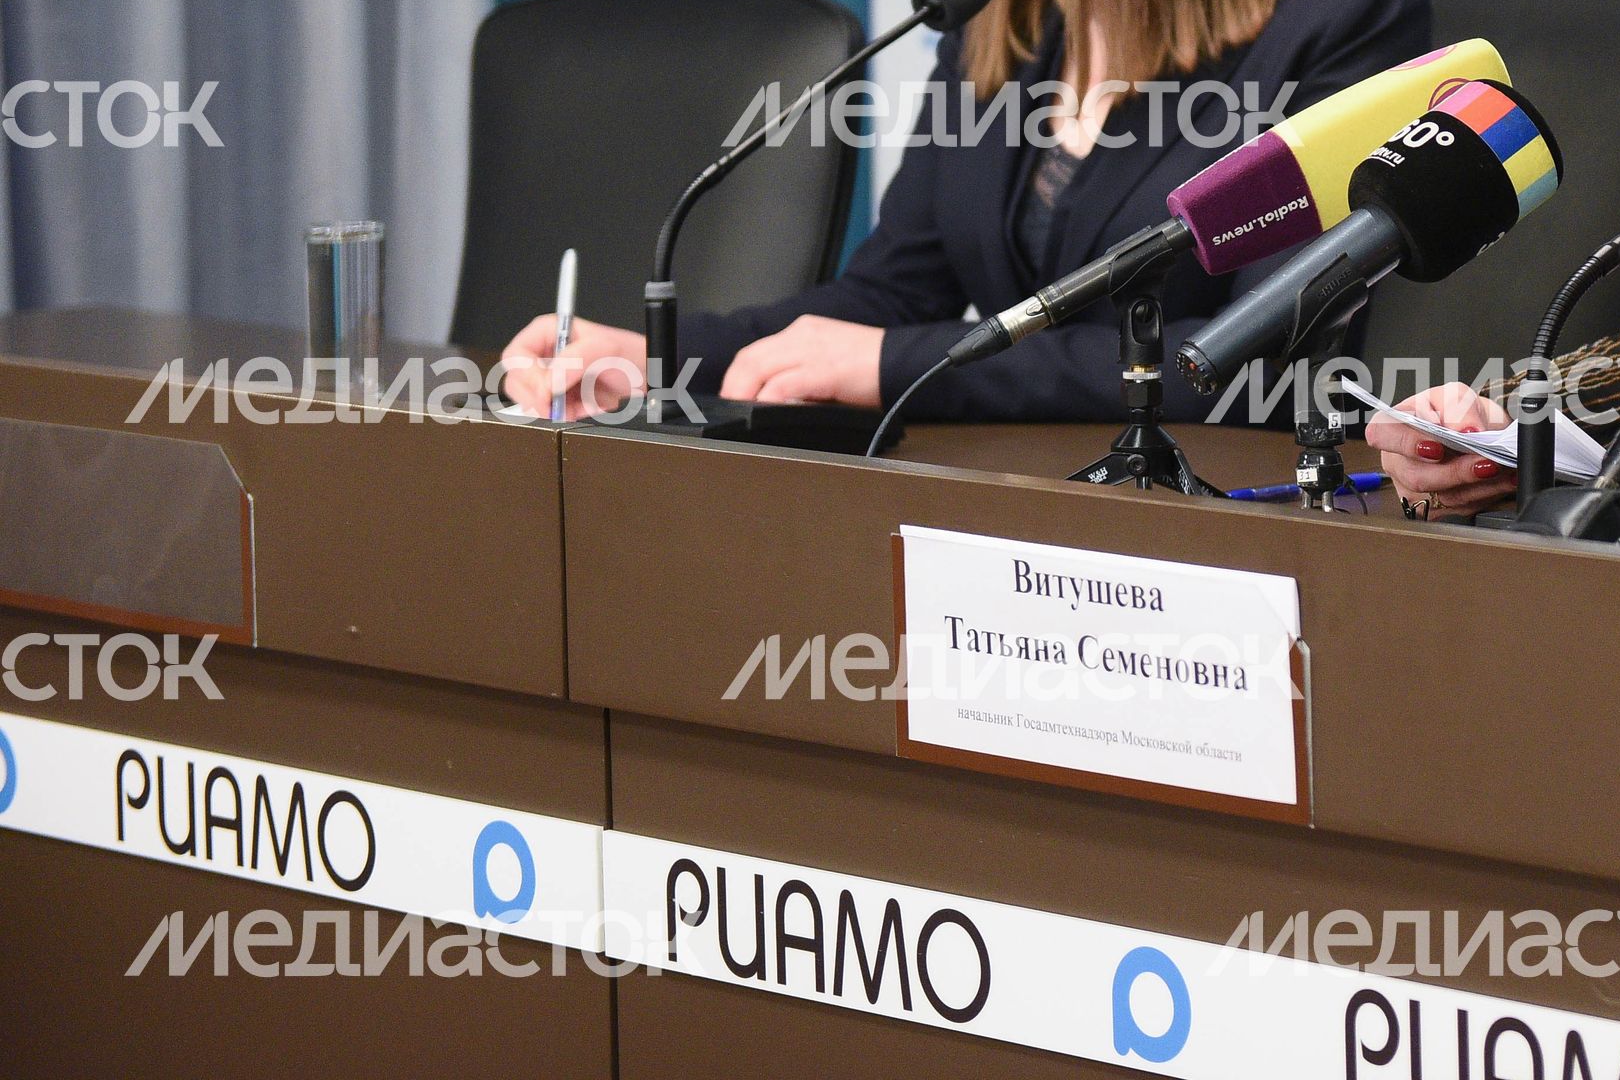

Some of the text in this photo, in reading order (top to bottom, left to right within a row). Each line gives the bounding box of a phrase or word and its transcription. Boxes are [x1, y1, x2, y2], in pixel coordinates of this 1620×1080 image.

[1211, 194, 1309, 247] Radio1.news
[1331, 415, 1339, 428] 5
[1012, 558, 1165, 612] Витушева
[944, 615, 1248, 691] Татьяна Семеновна
[957, 707, 1243, 763] начальник Госадмтехнадзора Московской области
[116, 749, 376, 892] РИАМО
[666, 858, 991, 1024] РИАМО
